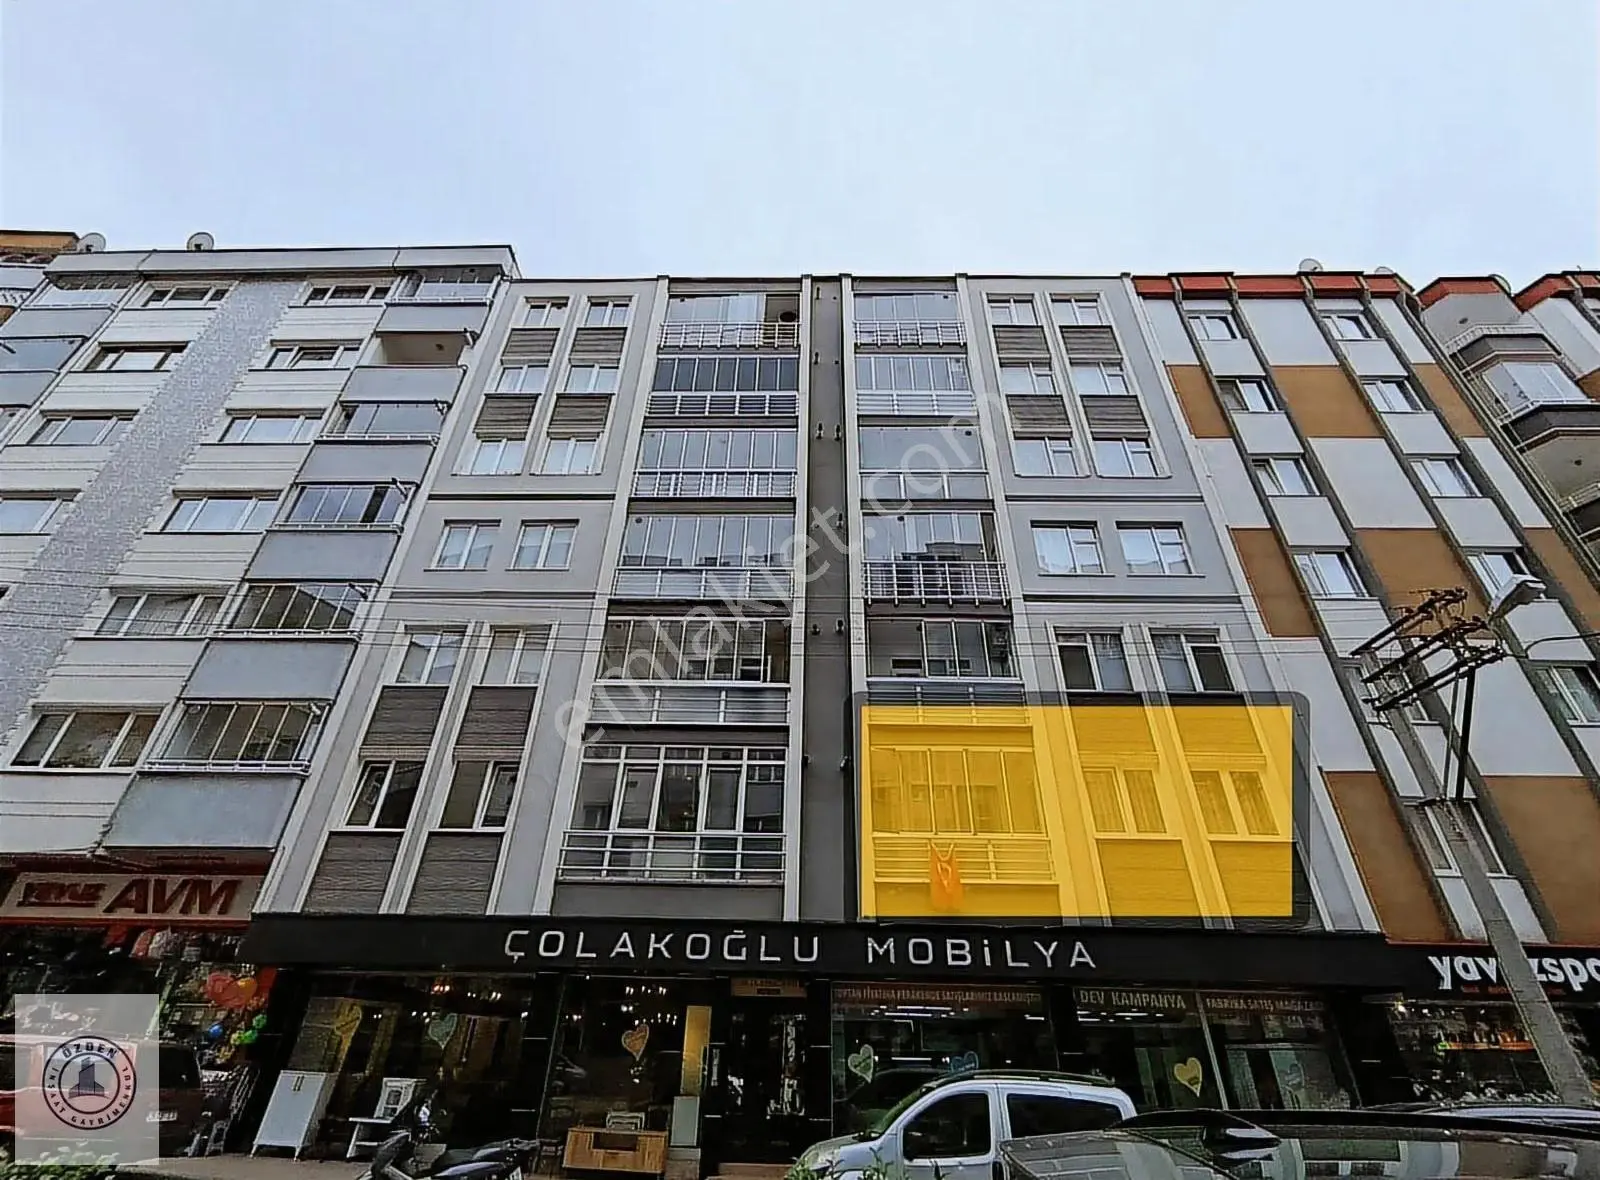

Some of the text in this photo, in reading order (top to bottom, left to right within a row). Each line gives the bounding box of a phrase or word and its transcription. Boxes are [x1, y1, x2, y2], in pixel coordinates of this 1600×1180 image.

[102, 877, 242, 915] AVM
[504, 929, 819, 964] ÇOLAKOĞLU
[1428, 955, 1600, 992] yavzsp
[1080, 990, 1186, 1009] DEV KAMPANYA
